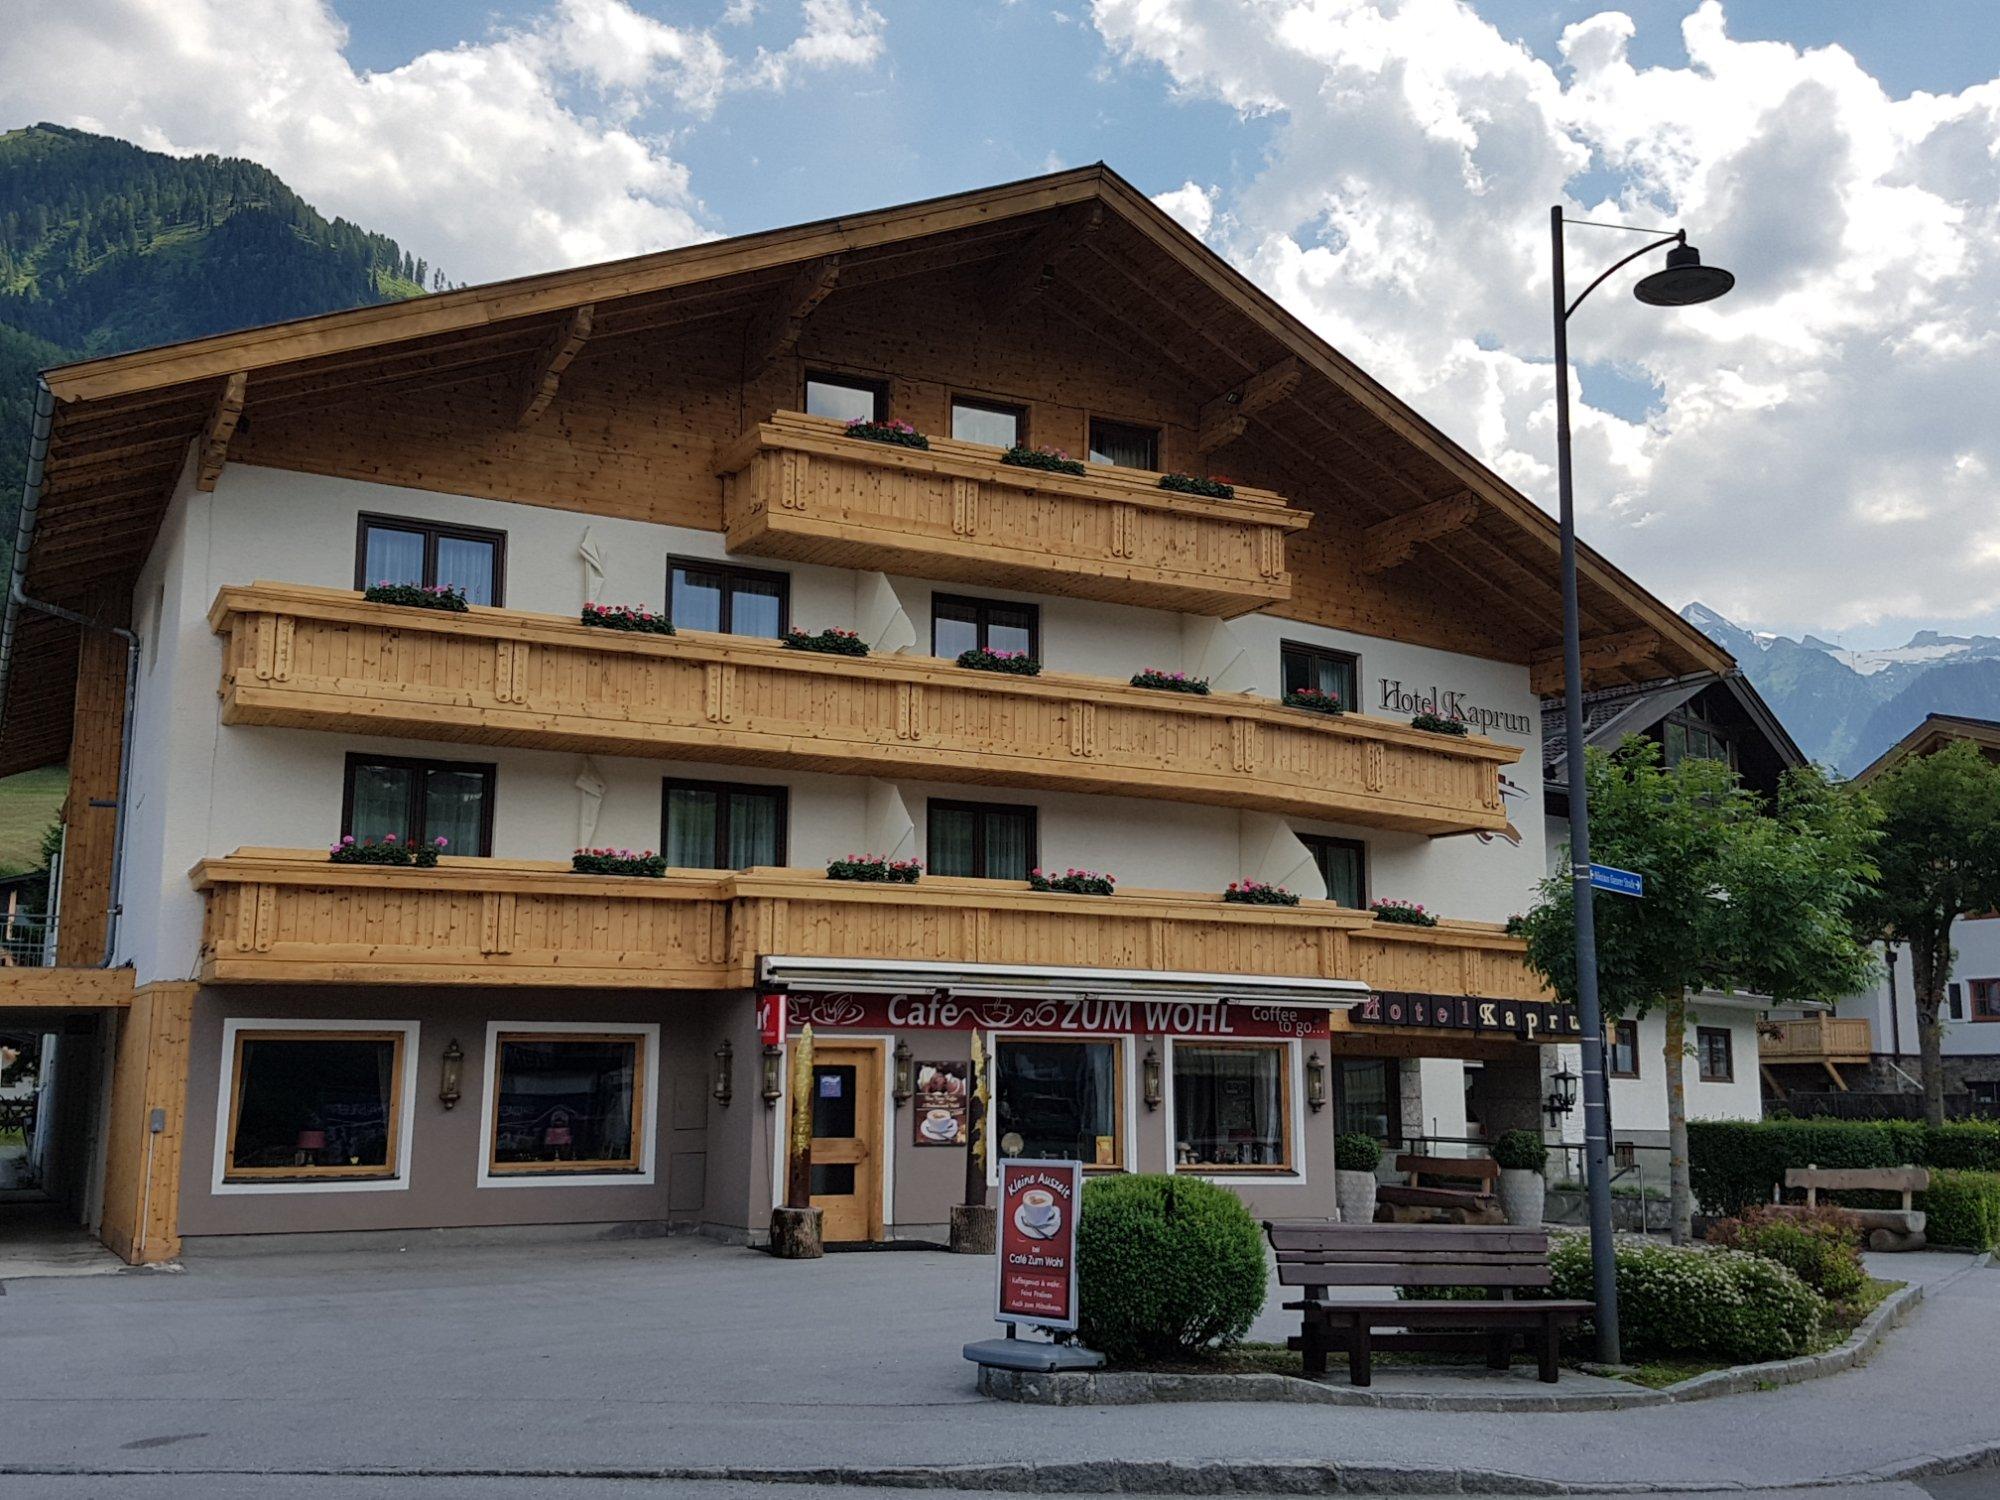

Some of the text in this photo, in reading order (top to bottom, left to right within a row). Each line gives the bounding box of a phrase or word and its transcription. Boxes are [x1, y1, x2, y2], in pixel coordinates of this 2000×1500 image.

[1379, 678, 1531, 735] Hotel Kaprun
[887, 994, 1235, 1033] Café ZUM WOHL
[1251, 1006, 1298, 1023] Coffee
[1362, 996, 1581, 1040] Hotel Kapru
[1279, 1020, 1325, 1037] to go...
[1007, 1172, 1072, 1199] Kleine Auszeit
[1009, 1253, 1064, 1268] Café Zum Wohl
